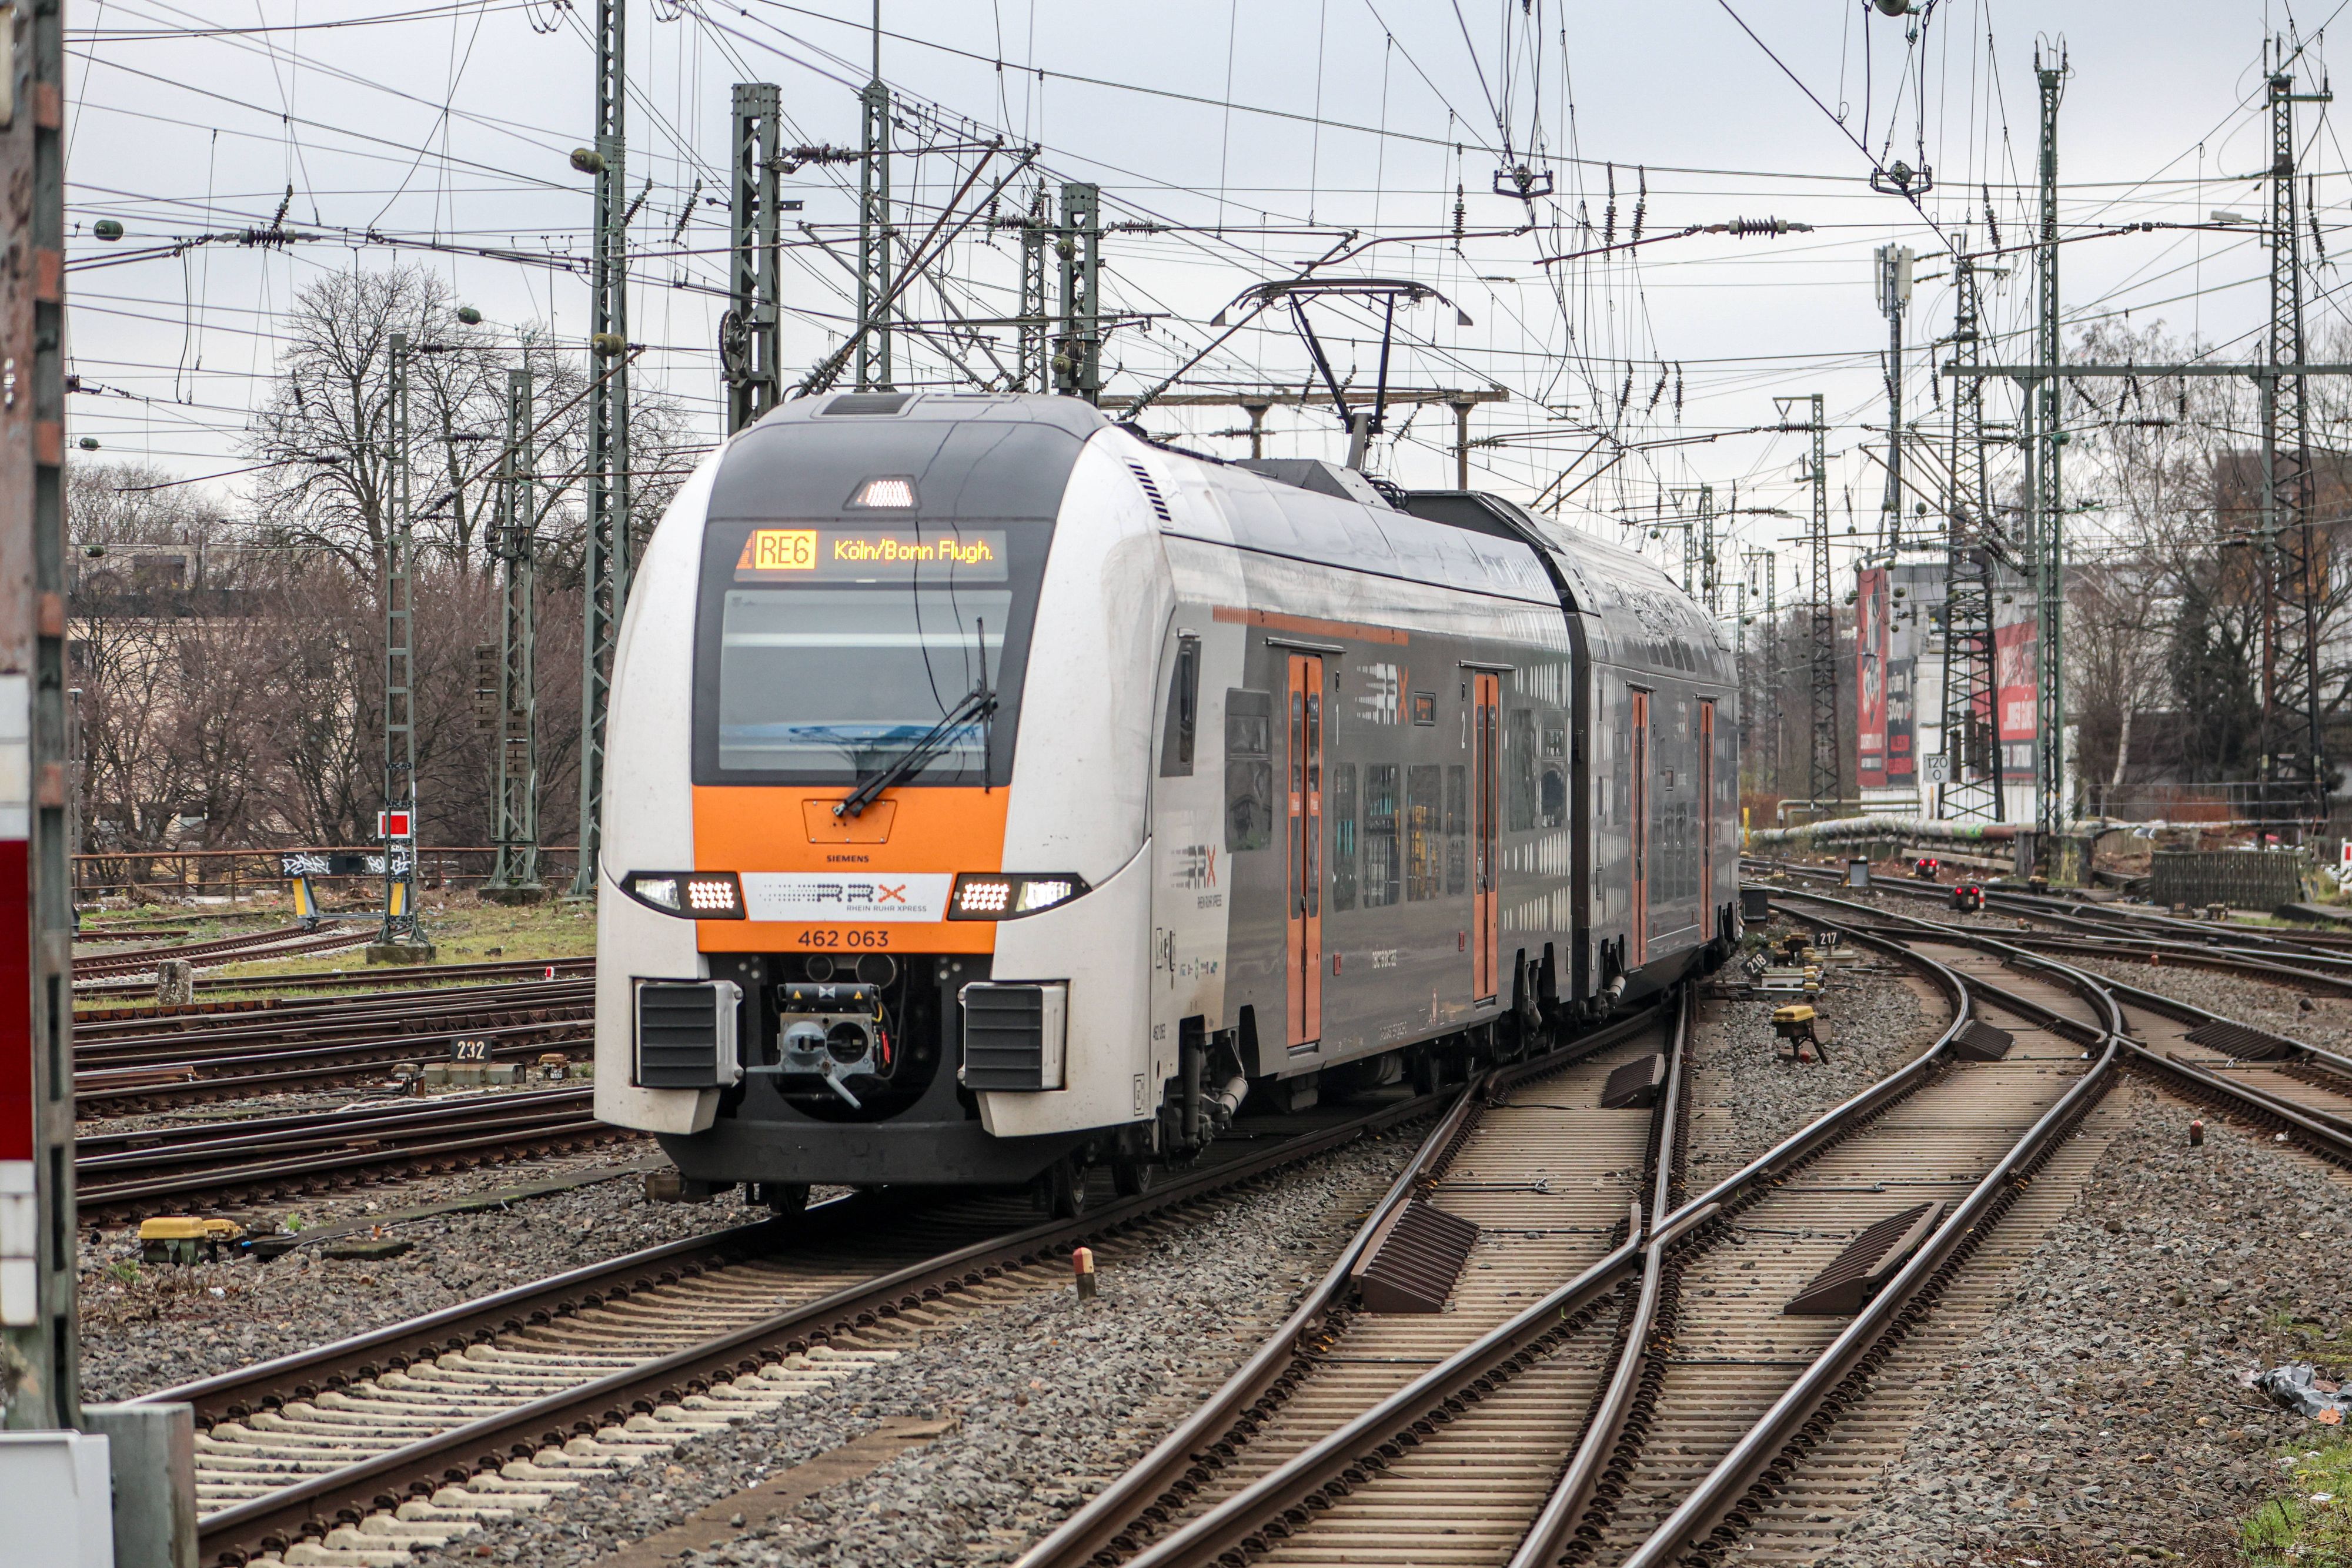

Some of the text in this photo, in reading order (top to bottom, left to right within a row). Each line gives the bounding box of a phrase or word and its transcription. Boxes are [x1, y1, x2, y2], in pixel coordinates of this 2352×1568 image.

[761, 536, 994, 564] RE6 Köln/Bonn Flugh.
[1928, 757, 1947, 768] 120
[1933, 770, 1942, 780] 0
[788, 884, 906, 903] RRX
[798, 930, 889, 947] 462 063
[1820, 932, 1838, 945] 217
[1746, 954, 1767, 974] 218
[457, 1041, 485, 1059] 232
